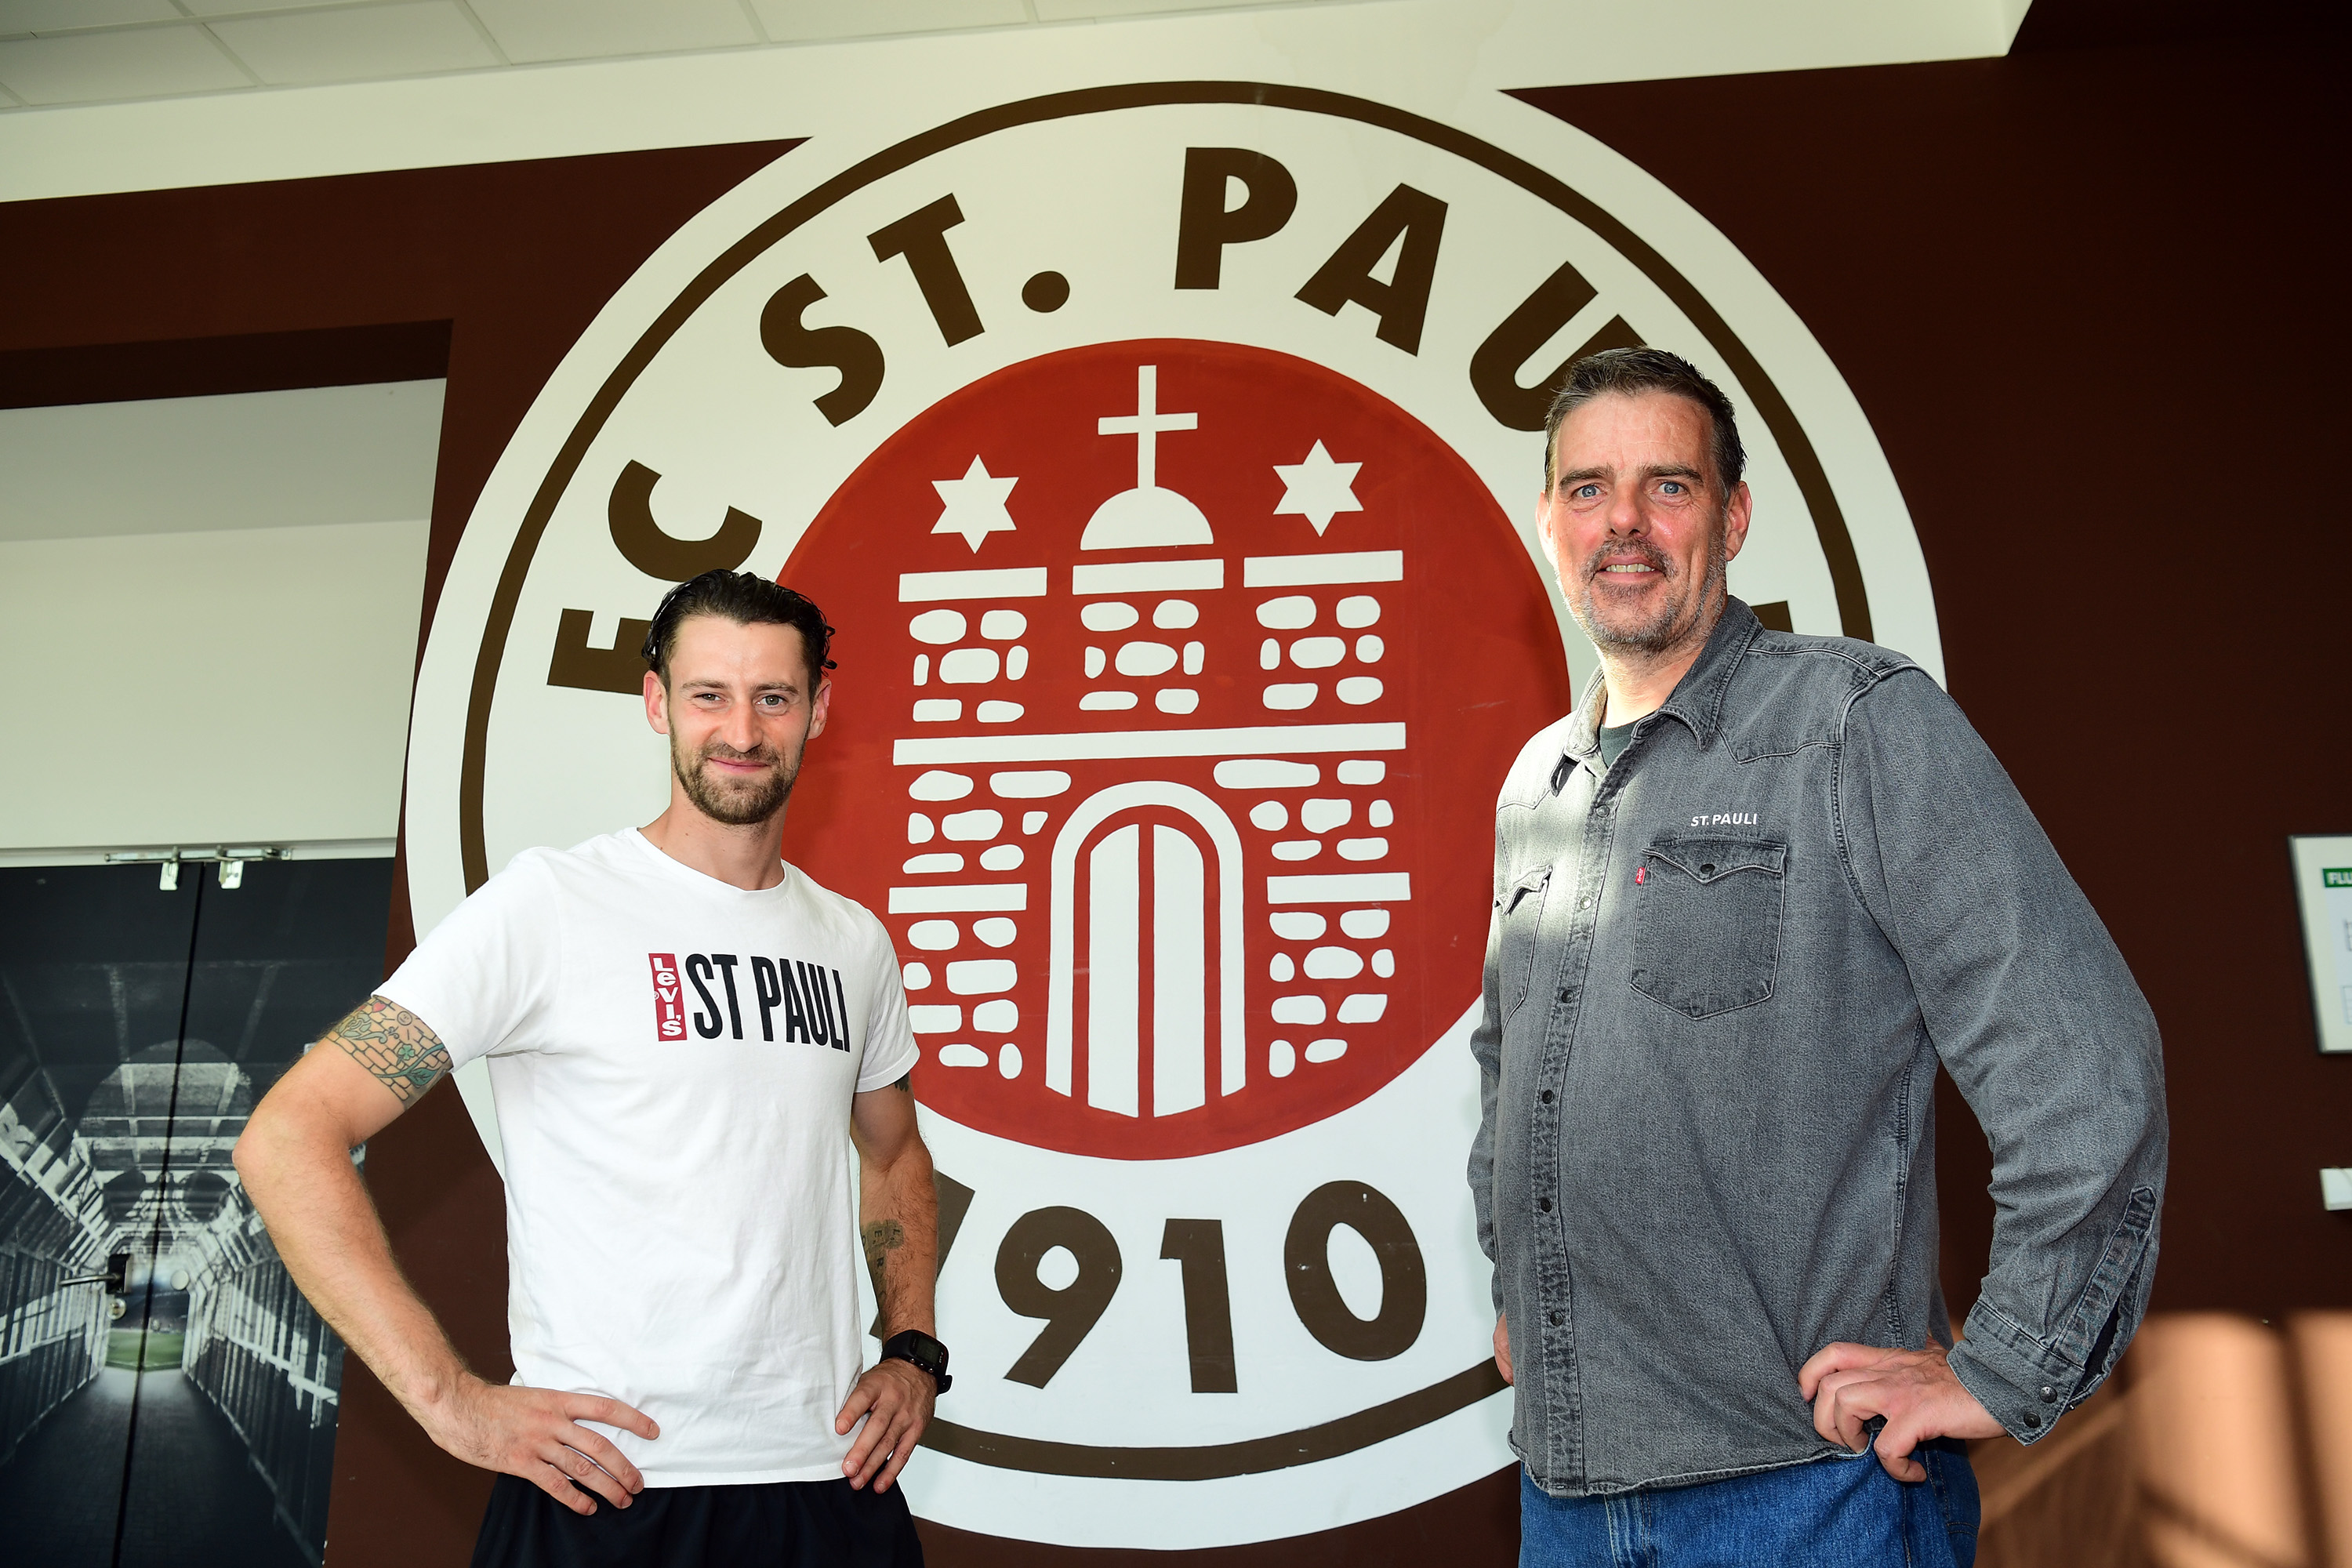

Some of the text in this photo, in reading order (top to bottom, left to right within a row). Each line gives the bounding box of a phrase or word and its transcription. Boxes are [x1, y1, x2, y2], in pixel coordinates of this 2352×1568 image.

[760, 192, 1071, 428] ST.
[1690, 812, 1758, 827] ST. PAULI
[685, 953, 851, 1053] ST PAULI
